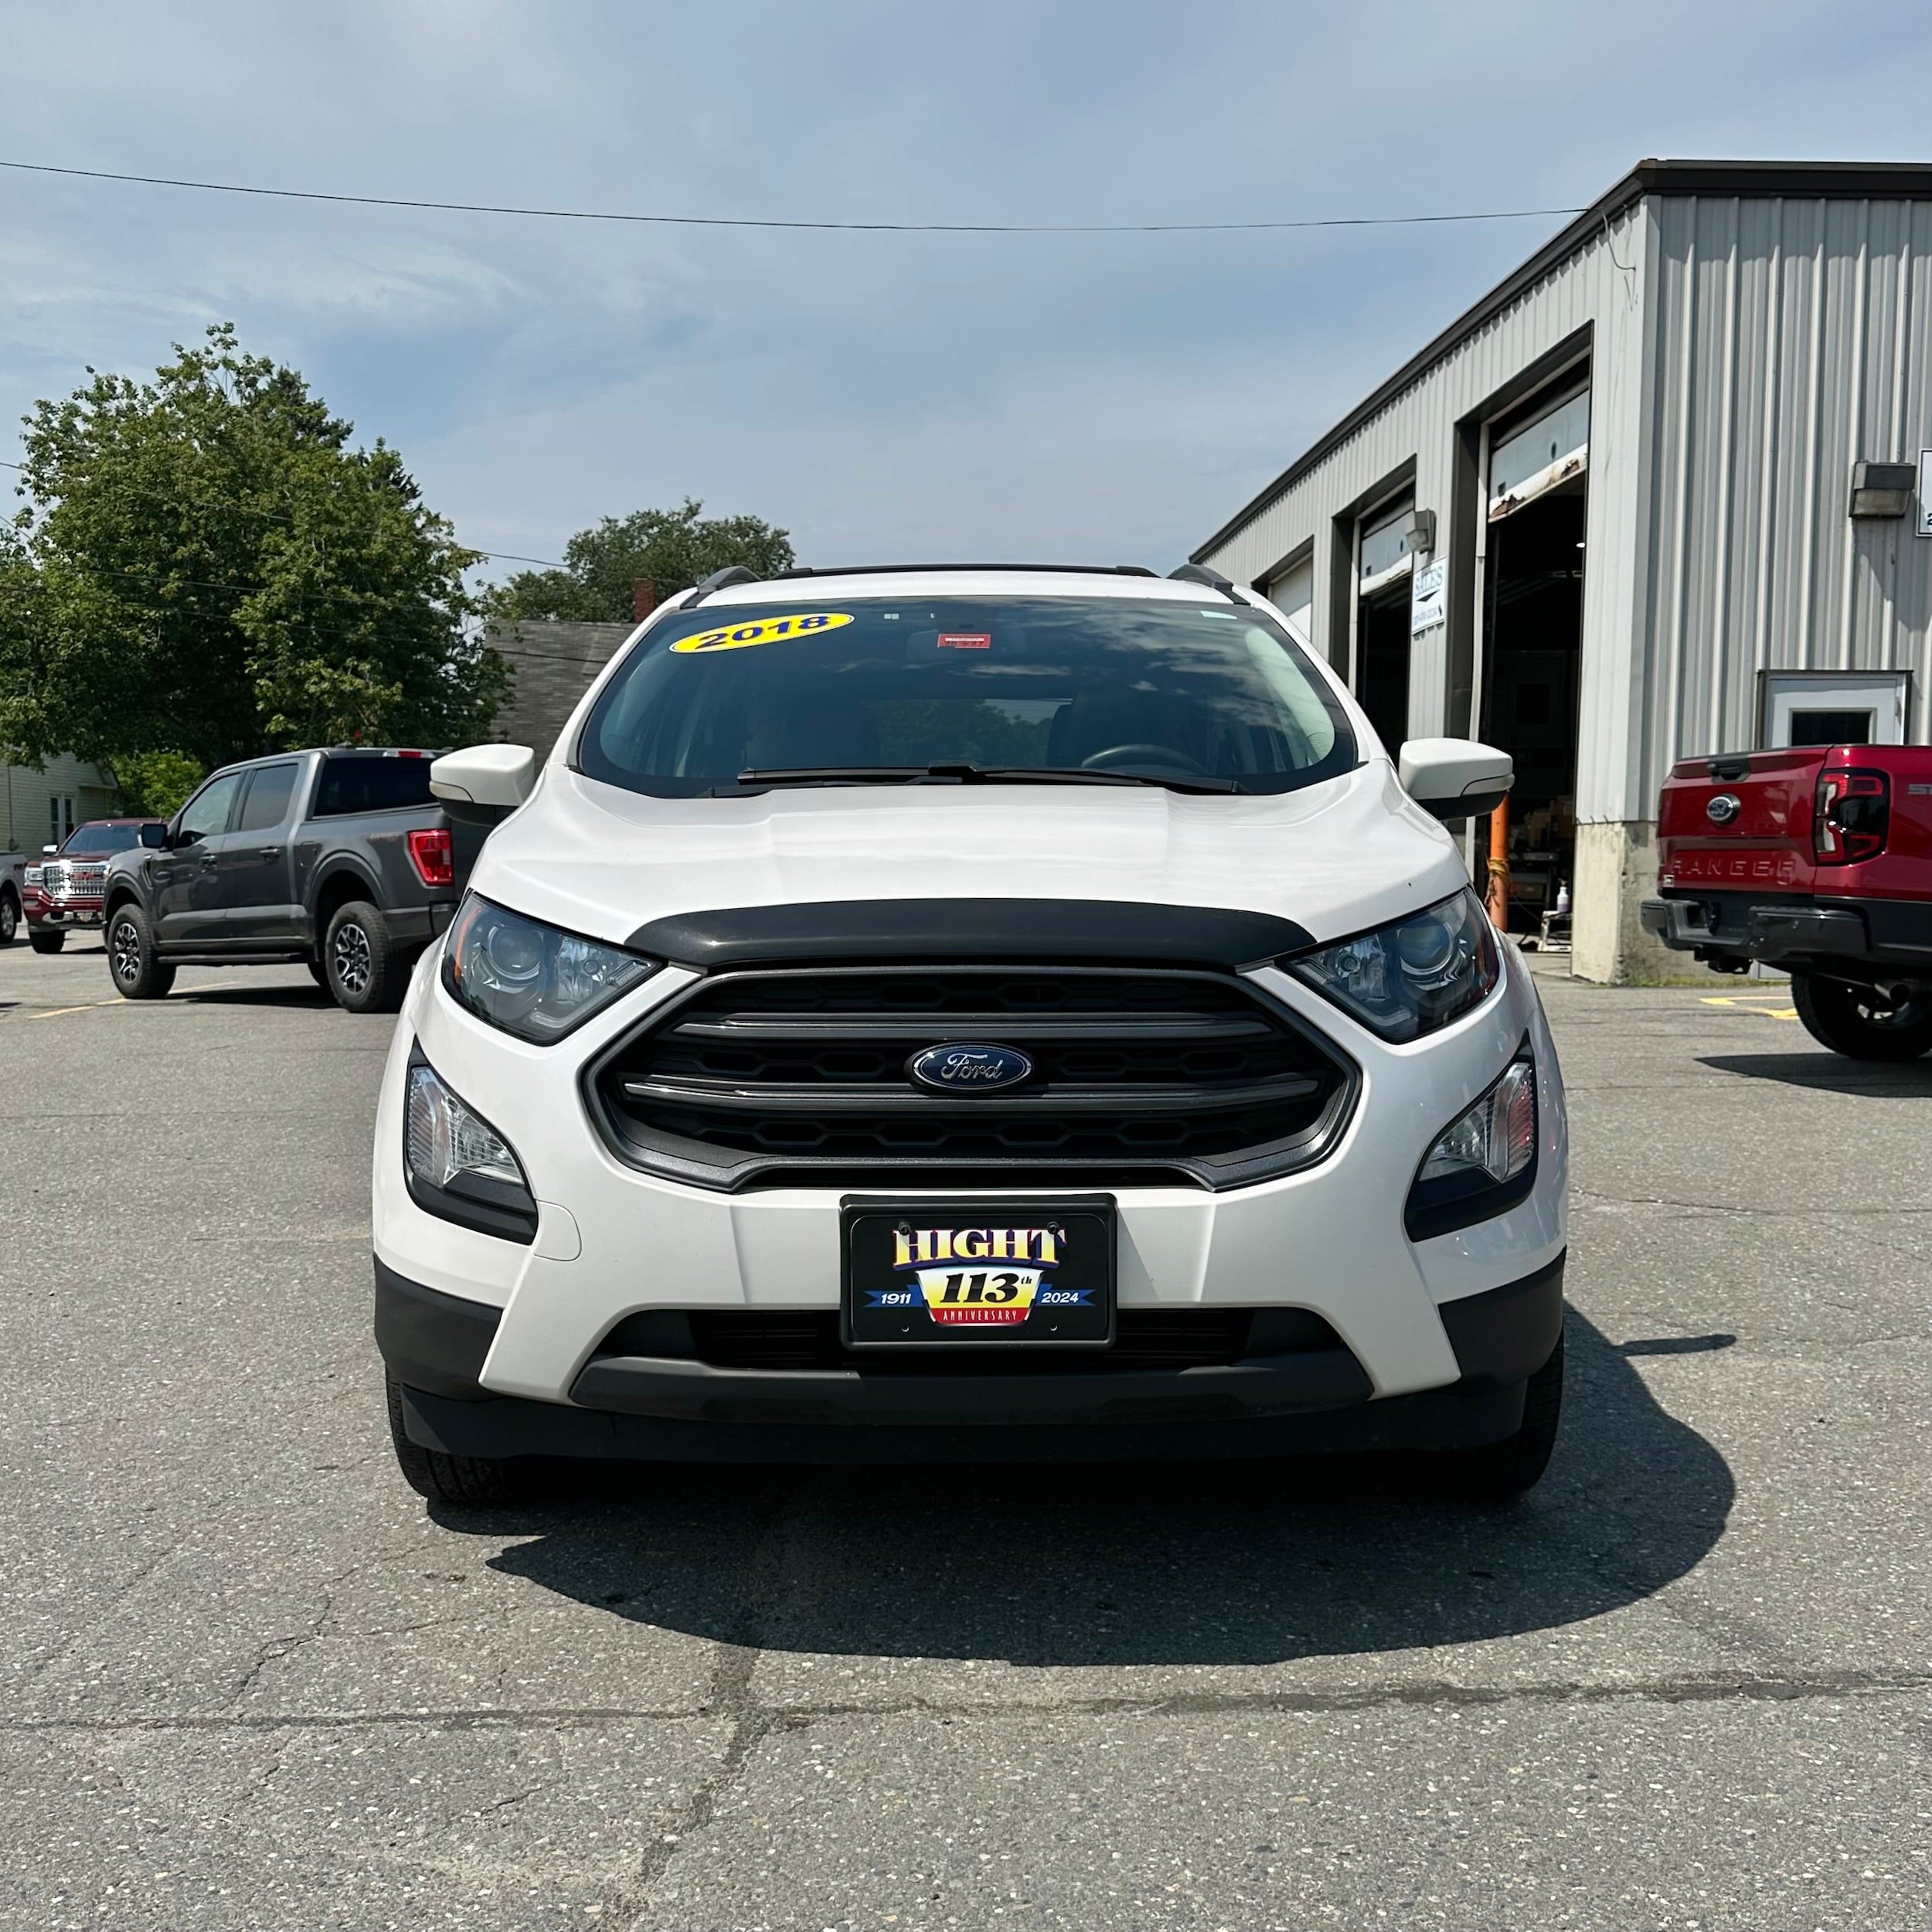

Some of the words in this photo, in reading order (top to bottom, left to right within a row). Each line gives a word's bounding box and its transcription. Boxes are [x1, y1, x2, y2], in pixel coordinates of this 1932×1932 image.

[695, 616, 830, 650] 2018
[940, 1053, 1004, 1080] Ford
[893, 1229, 1067, 1270] HIGHT
[880, 1292, 912, 1304] 1911
[1041, 1292, 1079, 1304] 2024
[942, 1310, 1018, 1322] ANNIVERSARY
